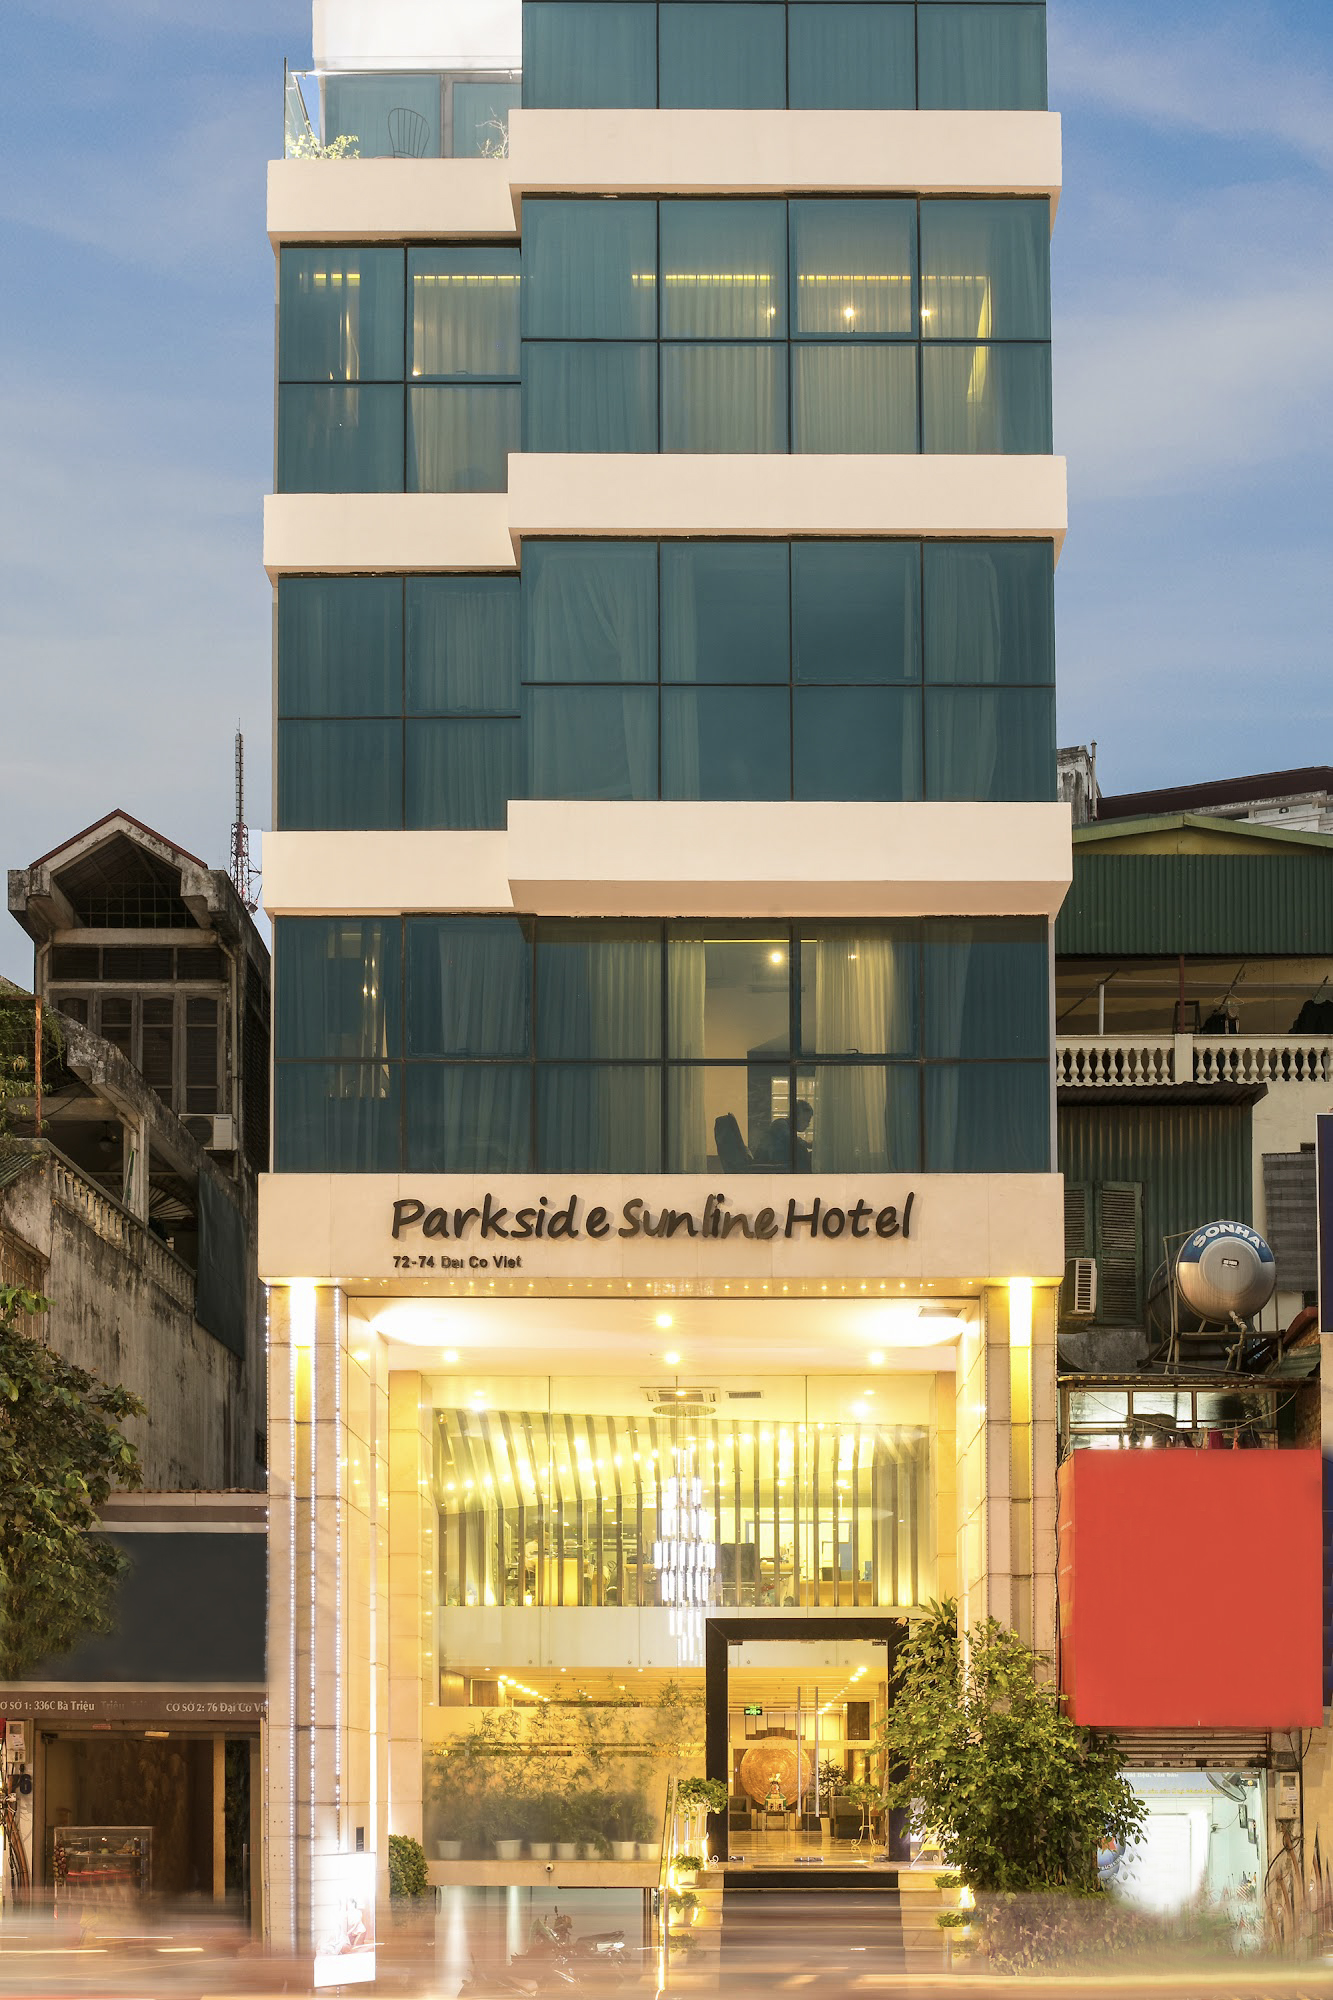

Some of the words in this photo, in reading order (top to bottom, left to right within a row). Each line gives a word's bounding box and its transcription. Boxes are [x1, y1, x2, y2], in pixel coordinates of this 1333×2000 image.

[392, 1192, 610, 1240] Parkside
[618, 1193, 779, 1240] Sunline
[784, 1191, 915, 1239] Hotel
[393, 1255, 435, 1269] 72-74
[468, 1255, 489, 1269] Co
[492, 1255, 523, 1269] Viet
[24, 1701, 32, 1711] 1:
[34, 1700, 56, 1711] 336C
[57, 1700, 69, 1711] Bà
[71, 1700, 95, 1713] Triệu
[207, 1702, 218, 1712] 76
